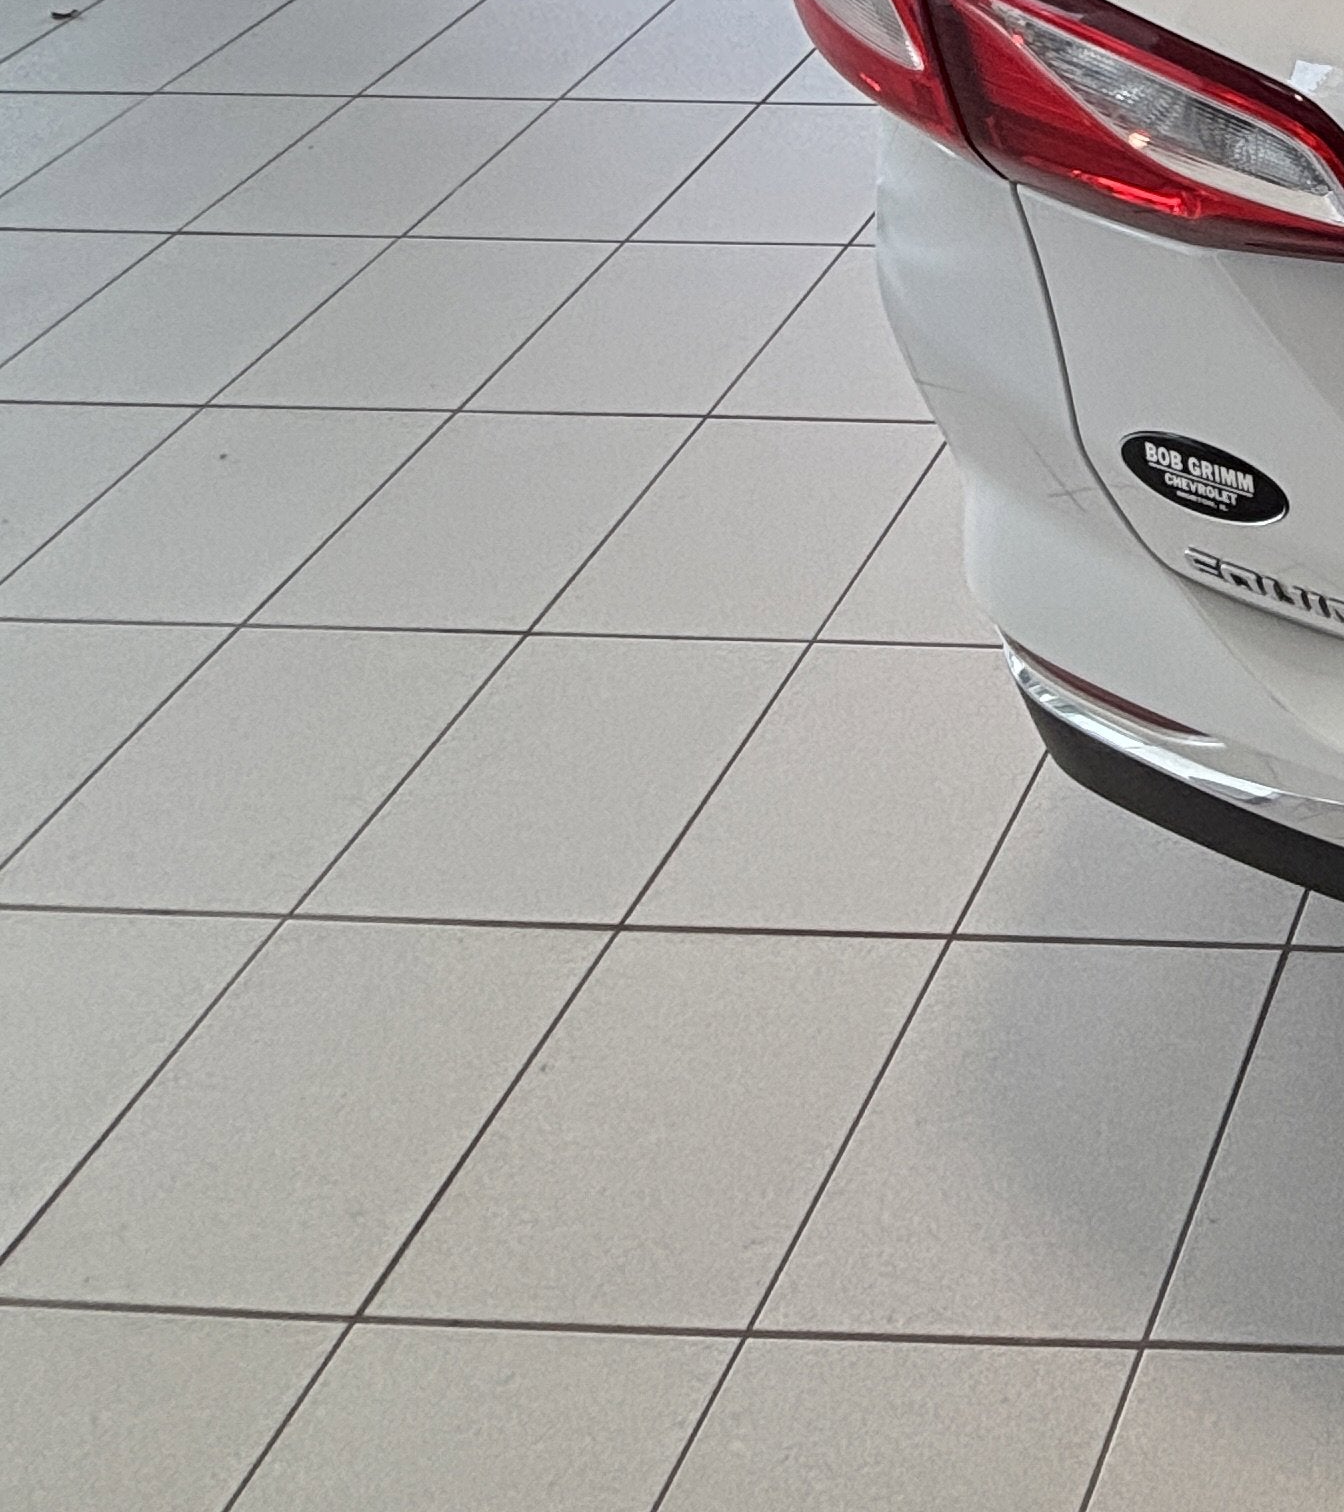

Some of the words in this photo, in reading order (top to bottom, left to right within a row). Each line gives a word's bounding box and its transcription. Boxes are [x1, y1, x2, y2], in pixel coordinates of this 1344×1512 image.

[1144, 441, 1184, 471] BOB
[1187, 456, 1255, 494] GRIMM
[1164, 472, 1238, 507] CHEVROLET
